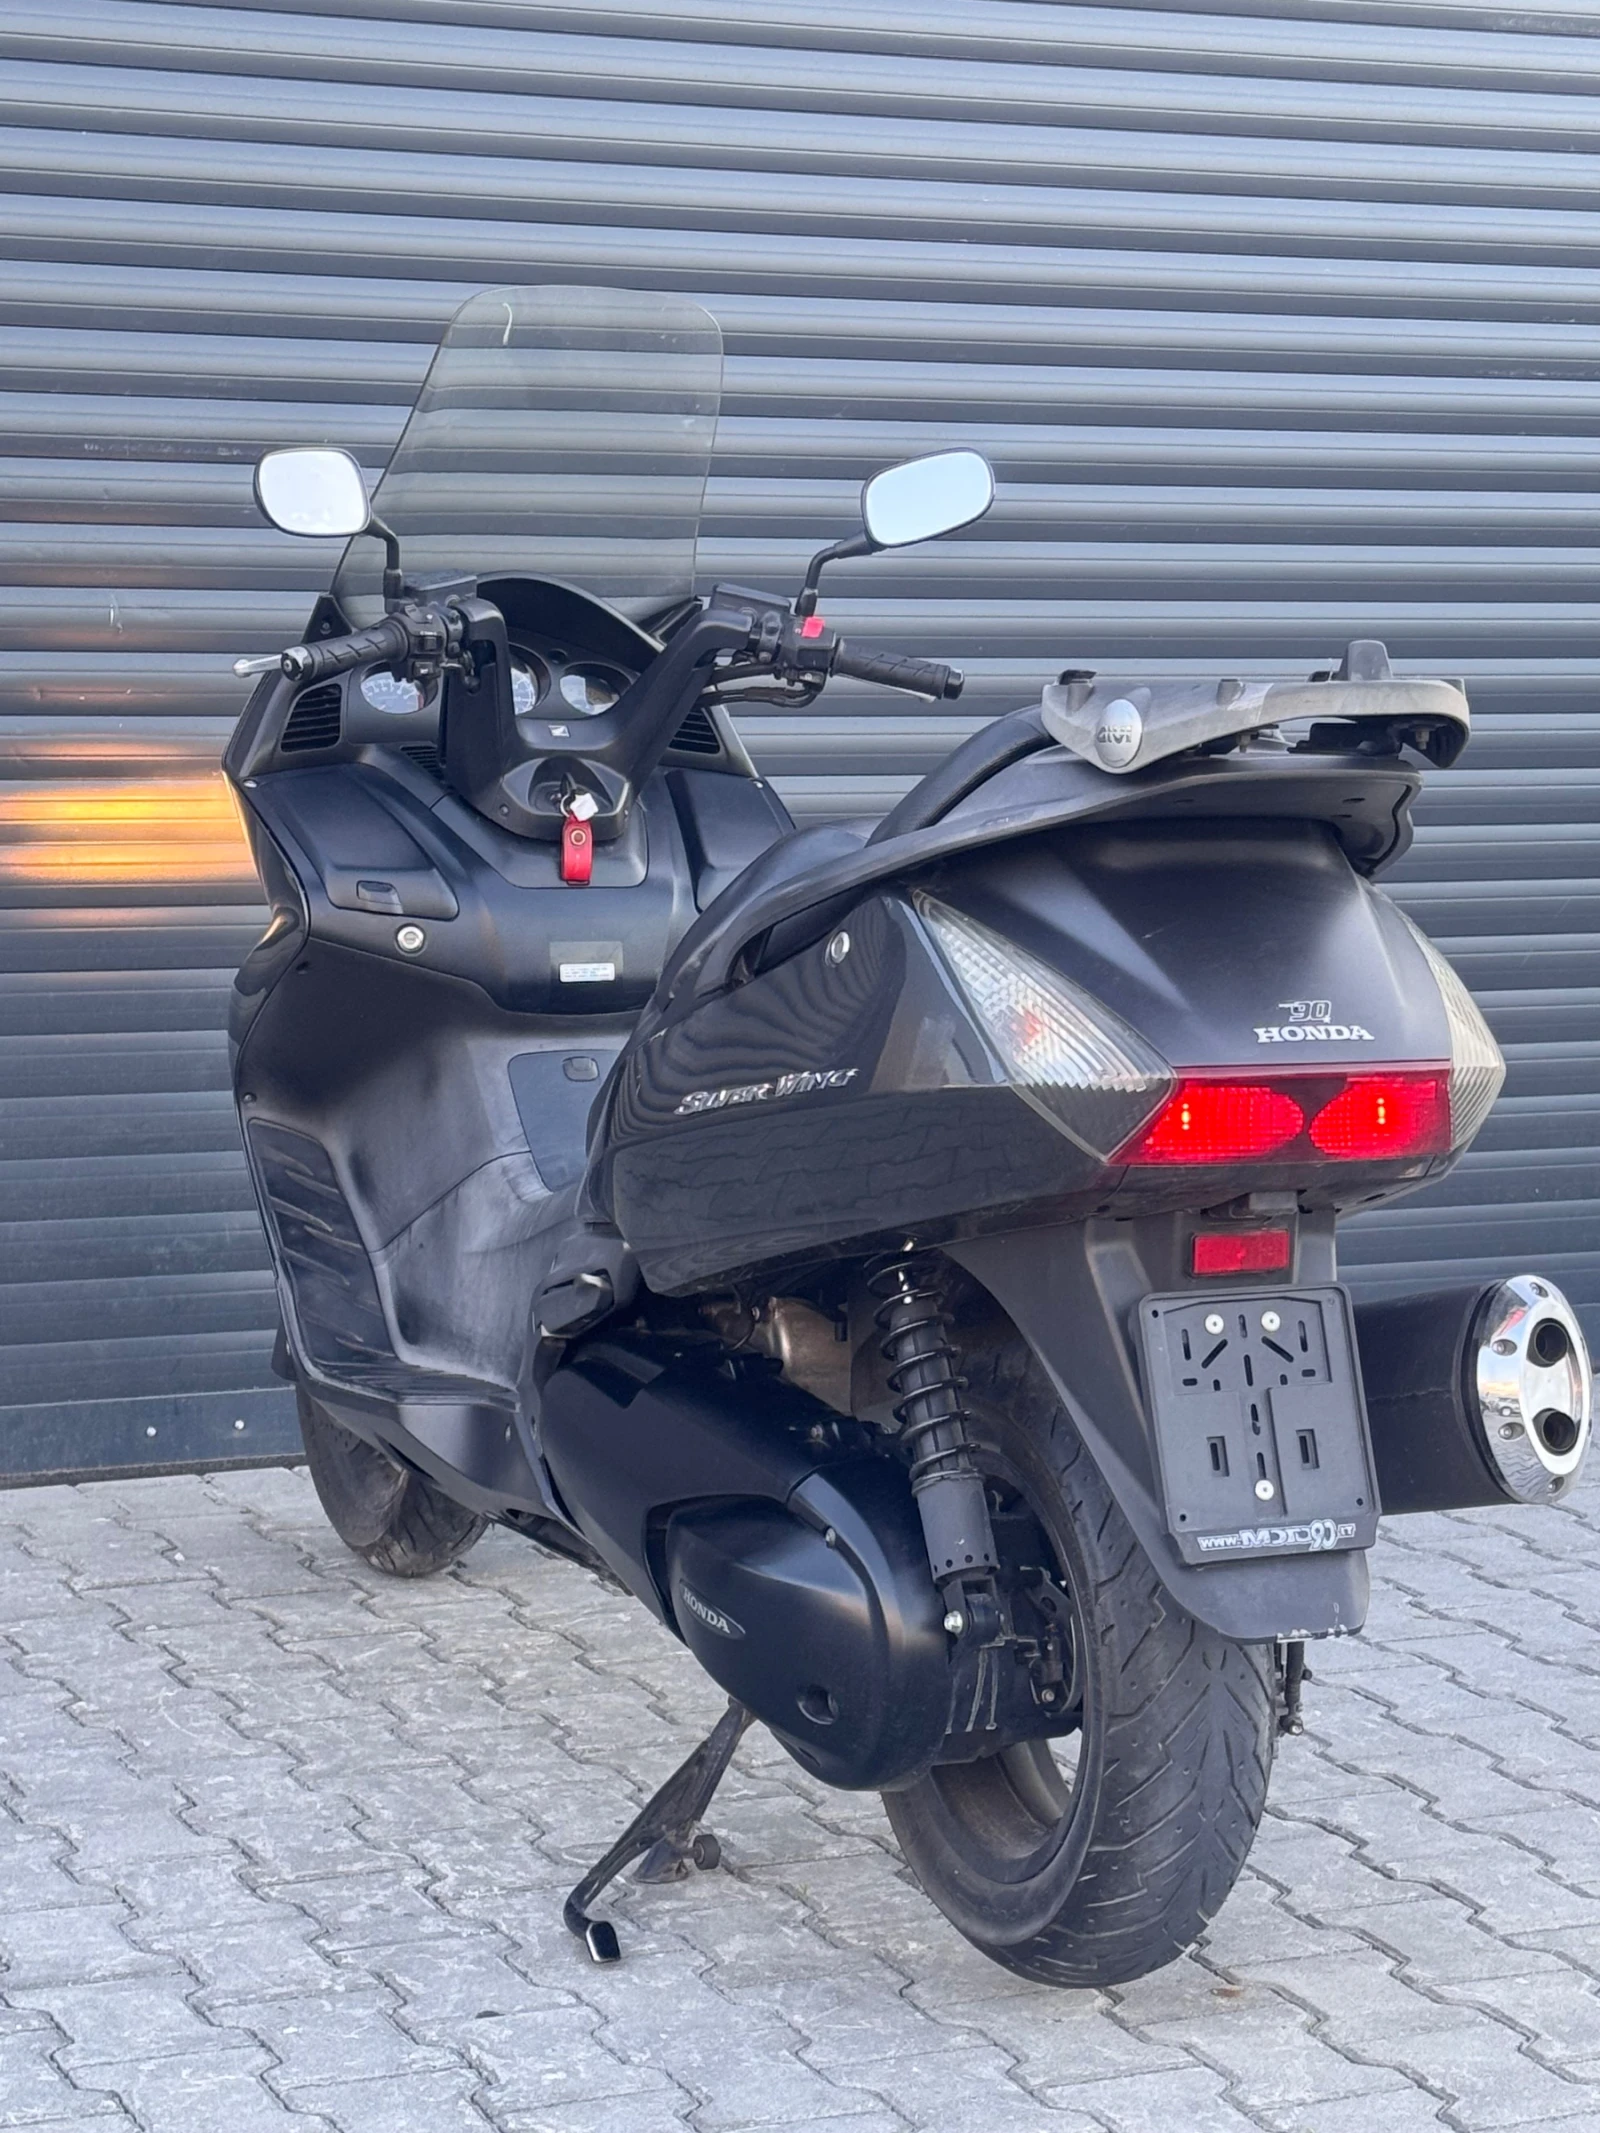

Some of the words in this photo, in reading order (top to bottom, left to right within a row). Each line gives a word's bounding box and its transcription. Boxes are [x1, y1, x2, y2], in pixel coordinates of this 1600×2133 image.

[1253, 1025, 1375, 1043] HONDA
[673, 1082, 774, 1116] SILVER
[775, 1068, 860, 1098] WING
[683, 1587, 731, 1634] HONDA
